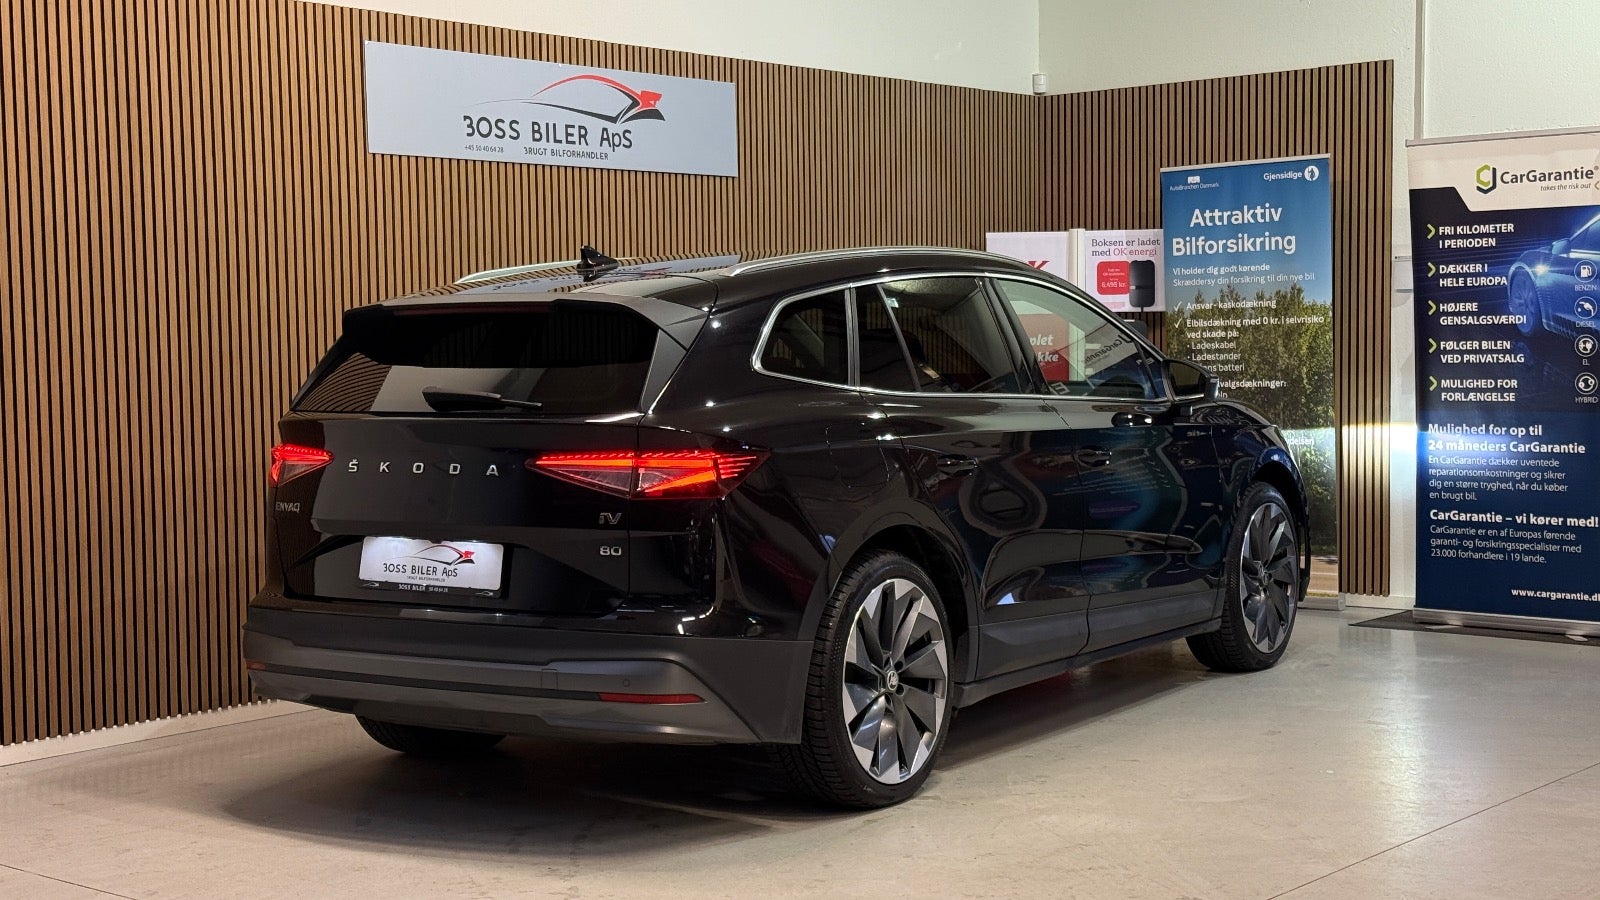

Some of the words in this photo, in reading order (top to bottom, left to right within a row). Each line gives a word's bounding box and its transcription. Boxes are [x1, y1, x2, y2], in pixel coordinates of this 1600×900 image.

[532, 121, 588, 146] BILER
[600, 127, 632, 152] ApS
[550, 149, 609, 160] BILFORHANDLER
[1264, 171, 1302, 182] Gjensidige
[1190, 203, 1282, 228] Attraktiv
[1439, 226, 1454, 235] FRI
[1457, 223, 1514, 235] KILOMETER
[1091, 239, 1124, 247] Boksen
[1173, 232, 1296, 256] Bilforsikring
[1439, 239, 1442, 248] I
[1445, 238, 1496, 248] PERIODEN
[1129, 248, 1157, 257] energi
[1173, 268, 1180, 276] Vi
[1181, 267, 1205, 275] holder
[1207, 266, 1218, 275] dig
[1220, 265, 1237, 274] godt
[1238, 263, 1270, 272] kørende
[1439, 264, 1482, 274] DÆKKER
[1485, 264, 1488, 272] I
[1173, 278, 1215, 287] Skræddersy
[1217, 276, 1229, 285] din
[1230, 275, 1266, 284] forsikring
[1277, 273, 1288, 281] din
[1289, 274, 1303, 283] nye
[1304, 272, 1315, 280] bil
[1440, 278, 1465, 287] HELE
[1467, 276, 1508, 287] EUROPA
[1186, 302, 1217, 310] Ansvar-
[1218, 300, 1276, 309] kaskodækning
[1440, 302, 1478, 312] HØJERE
[1187, 319, 1241, 328] Elbilsdækning
[1243, 317, 1261, 325] med
[1263, 317, 1268, 325] 0
[1270, 316, 1280, 325] kr.
[1286, 315, 1324, 324] selvrisiko
[1440, 315, 1527, 326] GENSALGSVÆRDI
[1187, 330, 1200, 339] ved
[1202, 329, 1225, 338] skade
[1227, 329, 1239, 340] på:
[1192, 341, 1236, 349] Ladeskabel
[1440, 340, 1479, 351] FØLGER
[1482, 340, 1511, 350] BILEN
[1192, 352, 1241, 361] Ladestander
[1440, 354, 1462, 363] VED
[1464, 354, 1525, 363] PRIVATSALG
[1218, 363, 1244, 371] batteri
[1441, 379, 1495, 389] MULIGHED
[1497, 379, 1518, 388] FOR
[1441, 392, 1516, 402] FORLÆNGELSE
[1428, 423, 1485, 437] Mulighed
[1489, 424, 1506, 435] for
[1510, 426, 1526, 438] op
[1529, 425, 1542, 436] til
[1428, 440, 1443, 450] 24
[1446, 440, 1506, 452] måneders
[1509, 441, 1585, 453] CarGarantie
[1440, 456, 1486, 465] CarGarantie
[1488, 457, 1518, 466] dækker
[1520, 458, 1559, 467] uventede
[348, 459, 499, 477] ŠKODA
[1429, 468, 1529, 480] reparationsomkostninger
[1530, 472, 1541, 480] og
[1544, 471, 1566, 479] sikrer
[1429, 479, 1442, 489] dig
[1480, 481, 1514, 491] tryghed,
[1516, 482, 1529, 490] når
[1531, 482, 1542, 491] du
[1544, 483, 1568, 492] køber
[1442, 491, 1463, 501] brugt
[1466, 492, 1477, 500] bil.
[276, 502, 300, 513] ENYAQ
[1430, 510, 1502, 523] CarGarantie
[1515, 514, 1526, 524] vi
[1530, 513, 1563, 526] kører
[1567, 516, 1599, 528] med!
[1430, 525, 1476, 535] CarGarantie
[1510, 529, 1542, 540] Europas
[1544, 531, 1576, 541] førende
[600, 546, 621, 556] 80
[1430, 538, 1460, 547] garanti-
[1462, 540, 1473, 548] og
[1475, 539, 1560, 552] forsikringsspecialister
[1562, 543, 1582, 553] med
[1431, 549, 1456, 557] 23.000
[1459, 550, 1504, 560] forhandlere
[1511, 553, 1519, 561] 19
[1522, 554, 1547, 563] lande.
[411, 565, 437, 576] BILER
[442, 567, 458, 578] ApS
